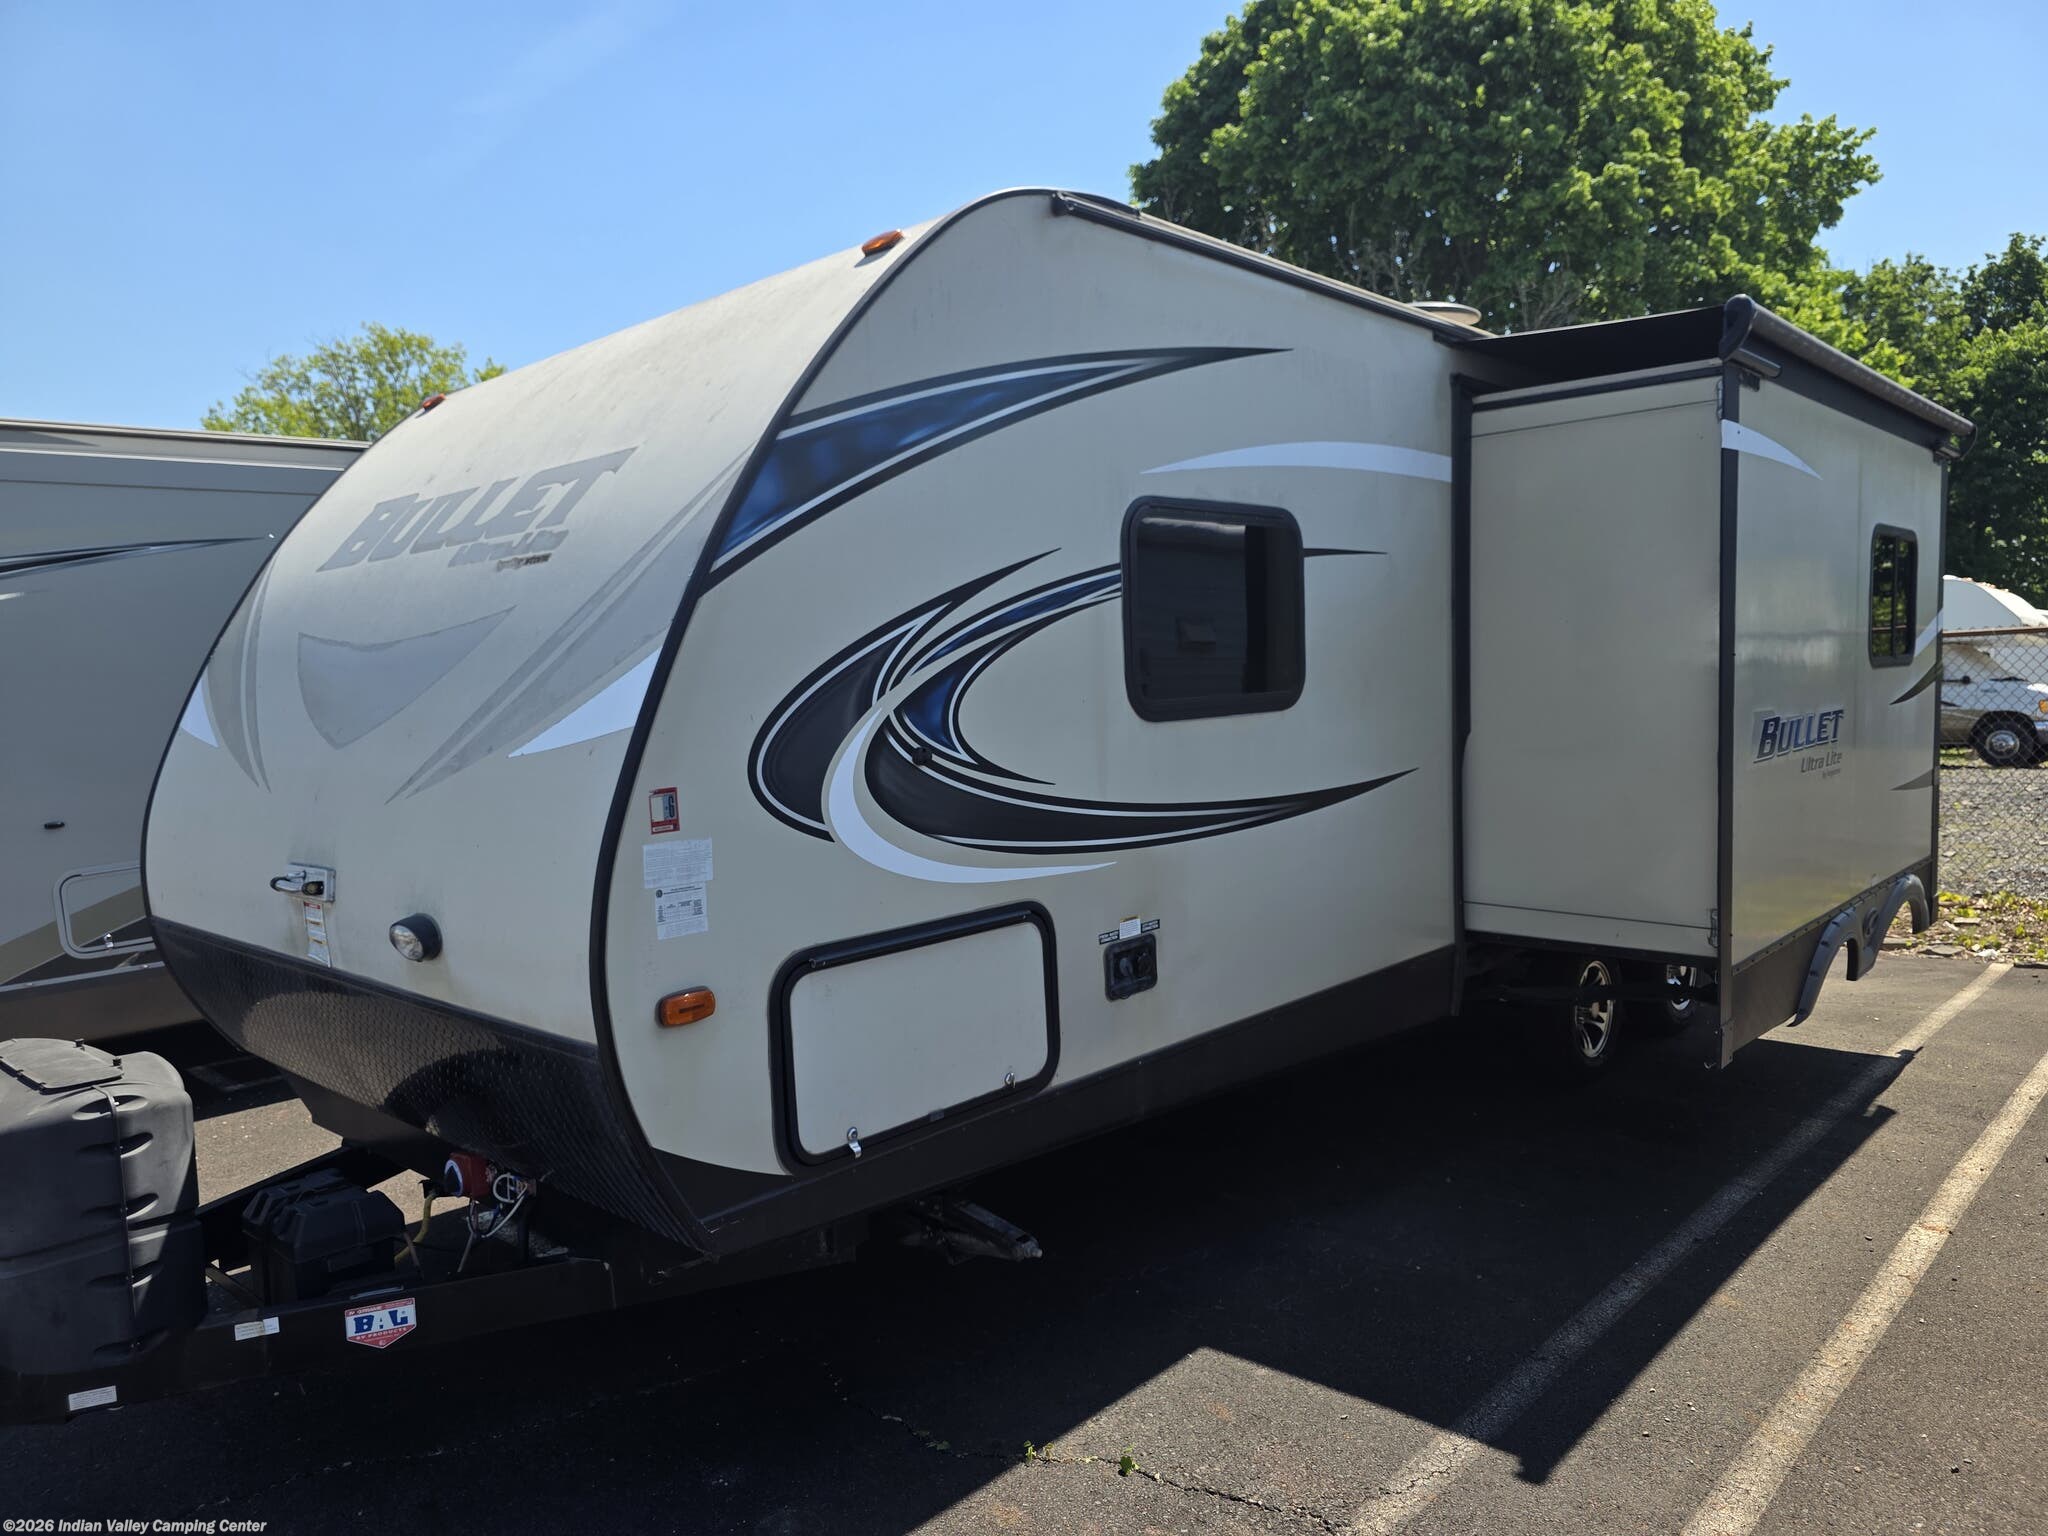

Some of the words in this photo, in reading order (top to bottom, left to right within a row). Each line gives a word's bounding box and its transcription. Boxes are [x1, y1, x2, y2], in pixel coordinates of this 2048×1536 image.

[316, 446, 638, 573] BULLET
[1754, 708, 1845, 763] BULLET
[1801, 757, 1825, 773] Ultra
[1826, 751, 1842, 767] Lite
[353, 1309, 409, 1334] BAL
